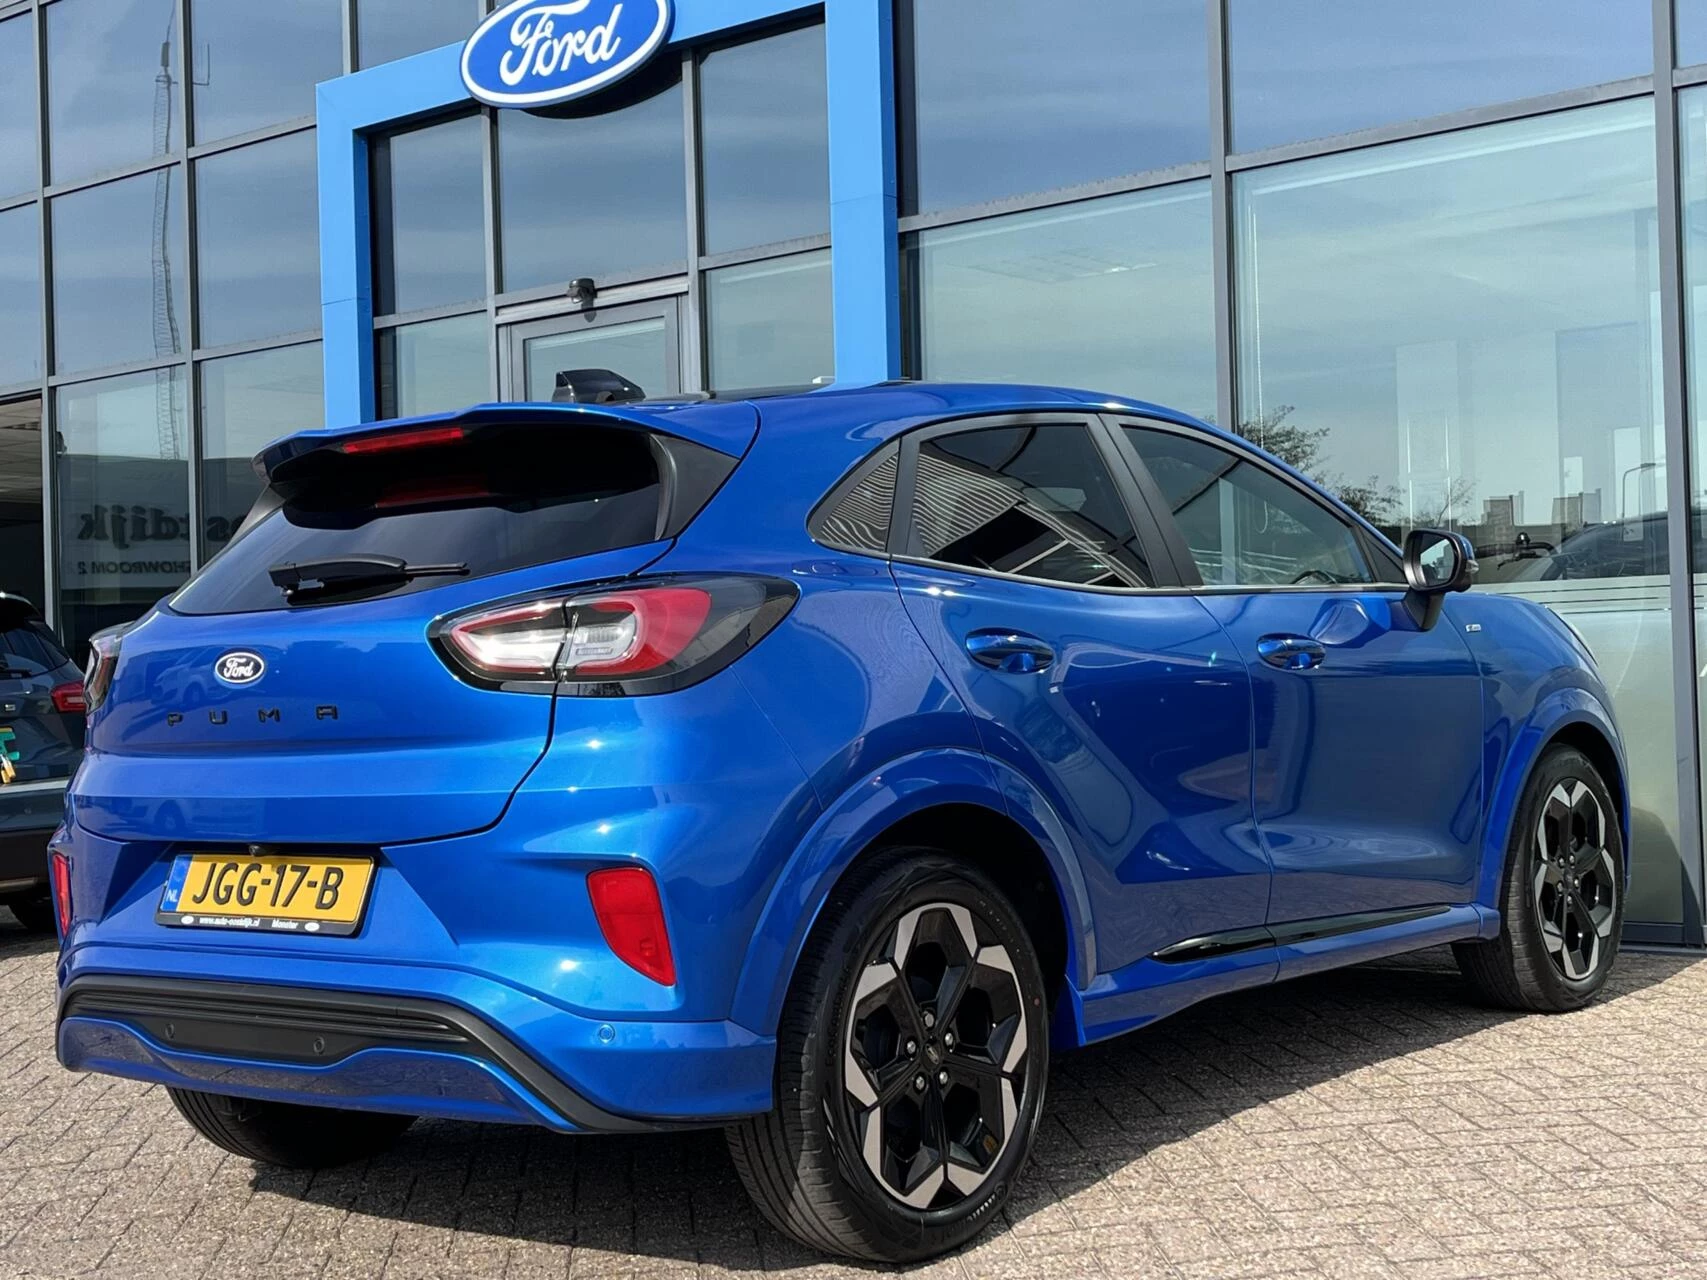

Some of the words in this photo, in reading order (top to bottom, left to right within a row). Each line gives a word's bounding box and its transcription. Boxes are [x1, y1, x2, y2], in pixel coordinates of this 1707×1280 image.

[499, 0, 623, 86] Ford
[223, 657, 254, 678] Ford
[167, 705, 338, 727] PUMA
[165, 888, 178, 902] NL
[192, 862, 344, 910] JGG-17-B
